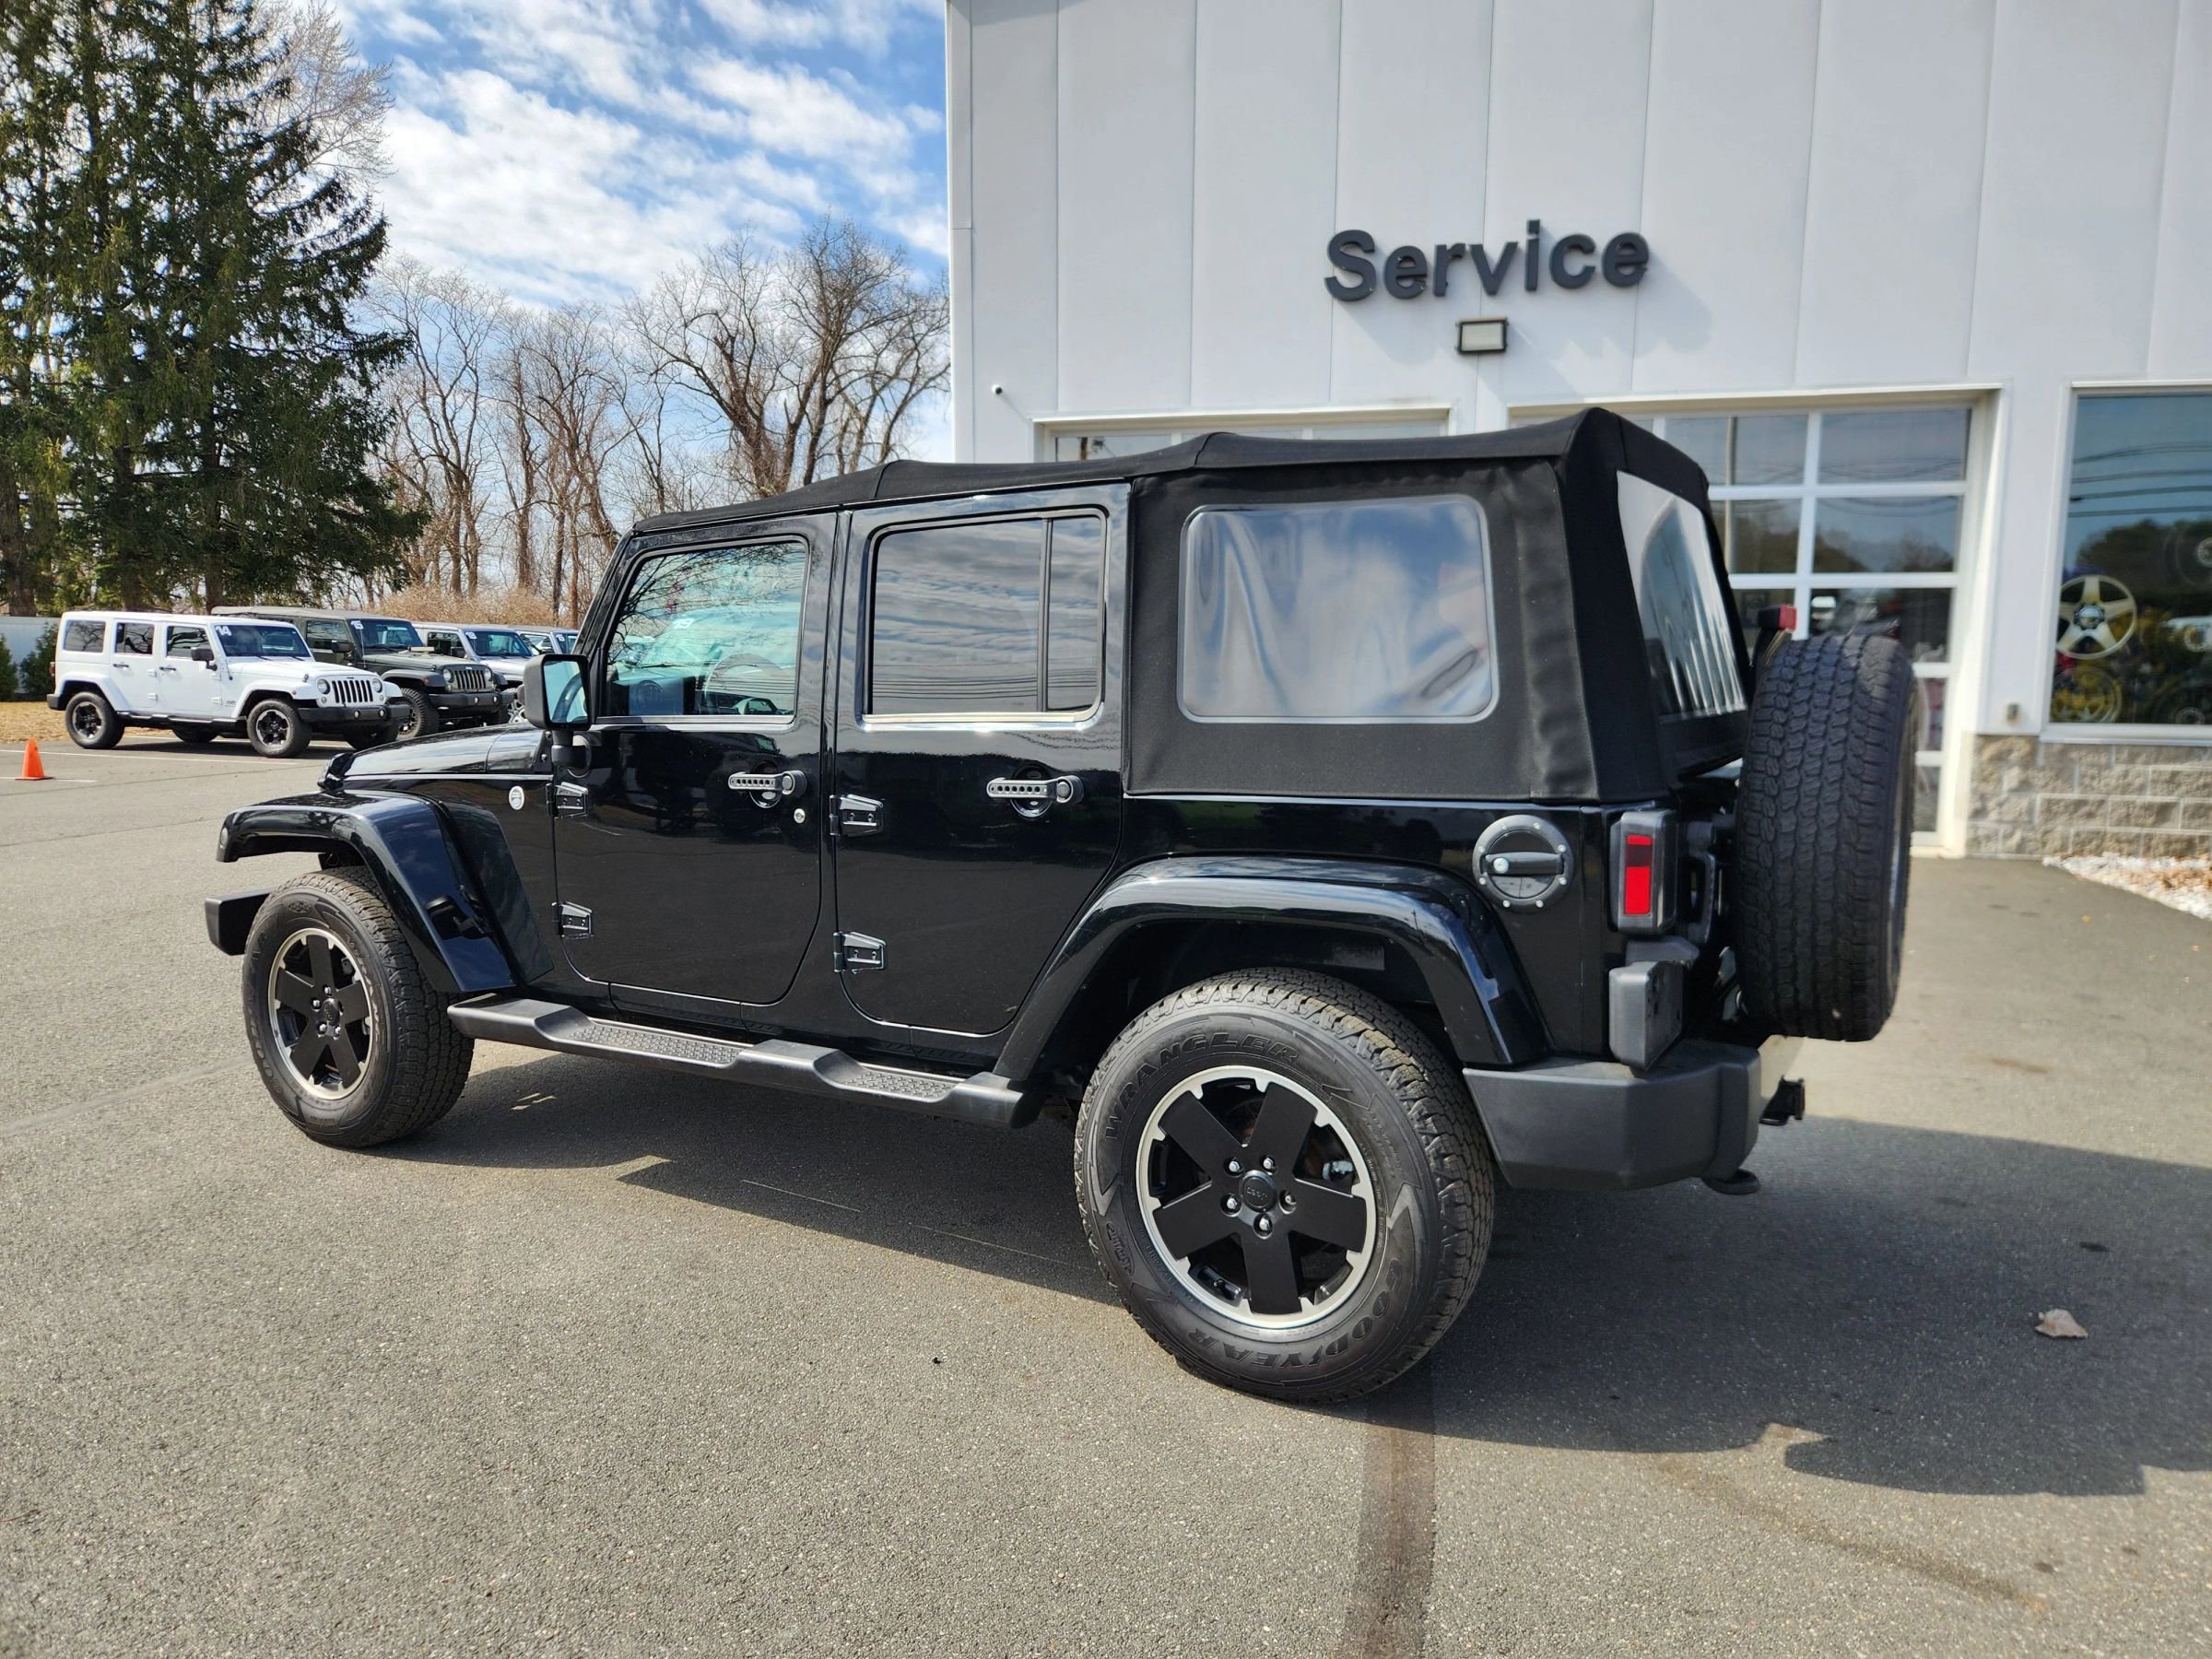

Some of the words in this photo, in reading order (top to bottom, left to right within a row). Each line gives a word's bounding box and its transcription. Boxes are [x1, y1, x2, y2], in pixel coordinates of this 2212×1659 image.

[1324, 219, 1649, 302] Service
[215, 625, 232, 636] 14
[350, 620, 364, 629] 15
[1105, 1031, 1299, 1139] WRANGLER
[1187, 1257, 1403, 1369] GOODYEAR
